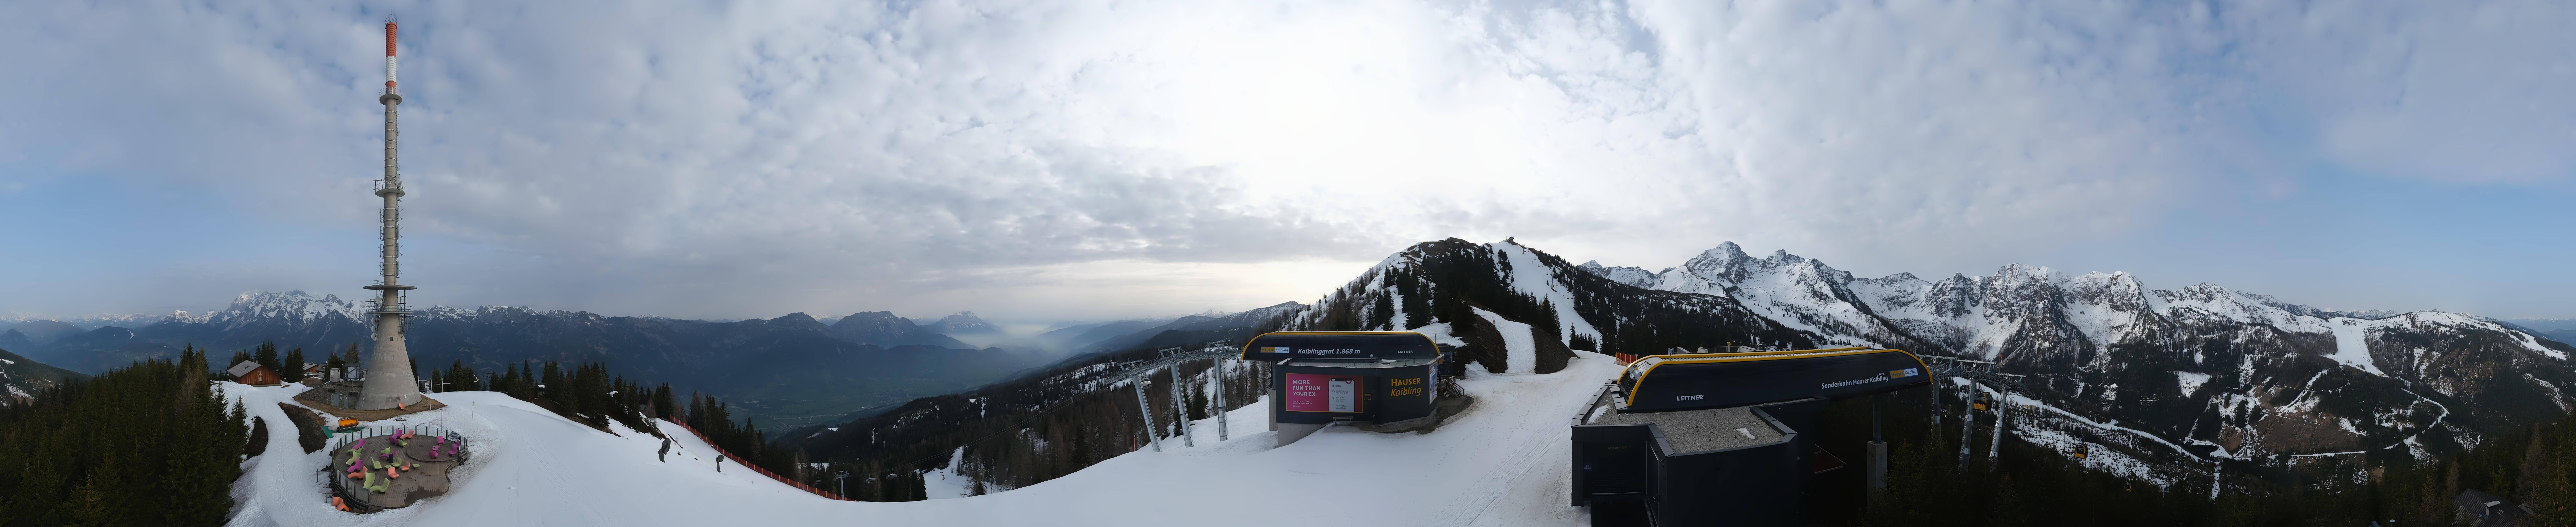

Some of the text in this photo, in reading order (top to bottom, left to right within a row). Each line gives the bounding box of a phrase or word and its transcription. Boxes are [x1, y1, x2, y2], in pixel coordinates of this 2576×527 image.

[1391, 378, 1421, 387] HAUSER
[1821, 379, 1852, 389] Senderbahn
[1391, 387, 1421, 396] Kaibling
